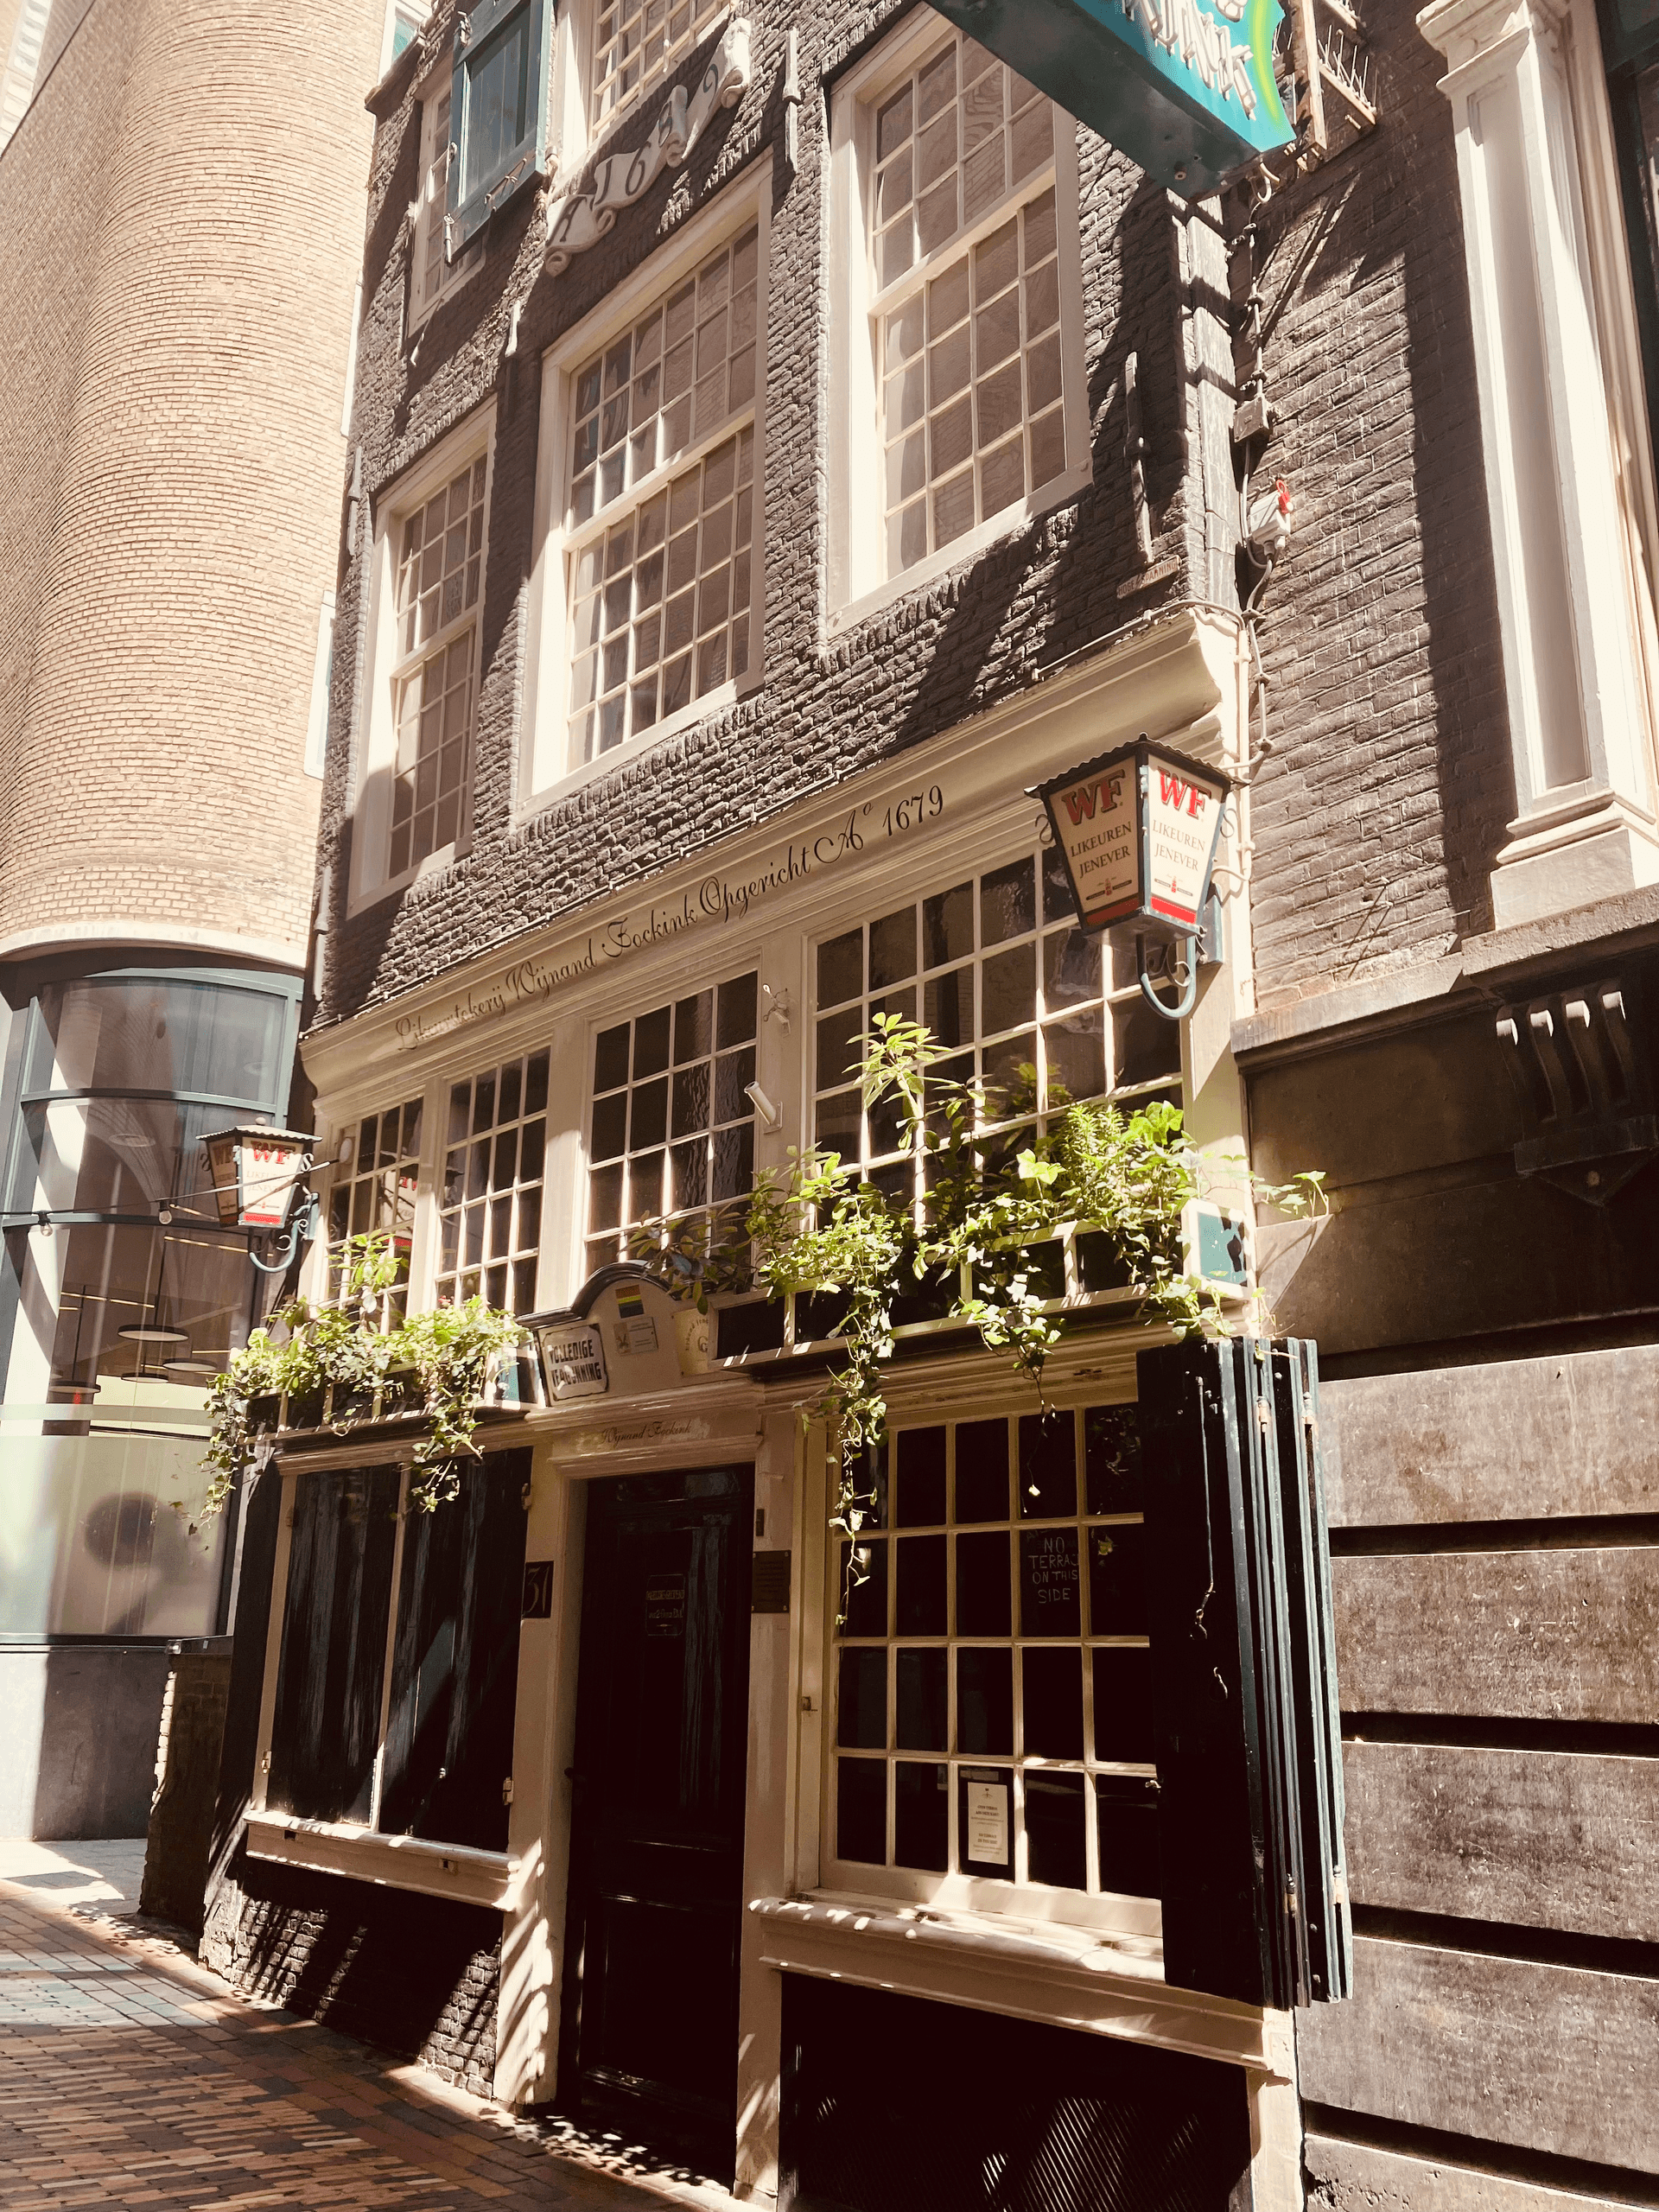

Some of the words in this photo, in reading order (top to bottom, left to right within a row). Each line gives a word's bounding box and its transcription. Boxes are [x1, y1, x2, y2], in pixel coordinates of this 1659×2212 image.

[1060, 768, 1126, 826] WF
[1157, 766, 1212, 820] WF
[1071, 821, 1133, 858] LIKEUREN
[1152, 819, 1206, 853] LIKEUREN
[1078, 845, 1130, 879] JENEVER
[1154, 842, 1199, 872] JENEVER
[395, 985, 507, 1051] Liketokerij
[602, 893, 698, 958] Fockink
[699, 846, 811, 924] Opgericht
[881, 785, 945, 838] 1679
[251, 1141, 296, 1165] WF
[246, 1170, 289, 1183] LIKE
[248, 1184, 284, 1194] JENEV
[548, 1338, 594, 1364] VOLLEDIGE
[1044, 1536, 1065, 1554] NO
[1028, 1554, 1080, 1569] TERRAC
[522, 1565, 550, 1617] 31
[1032, 1571, 1049, 1585] ON
[1052, 1569, 1078, 1581] THIS
[1038, 1587, 1071, 1604] SIDE
